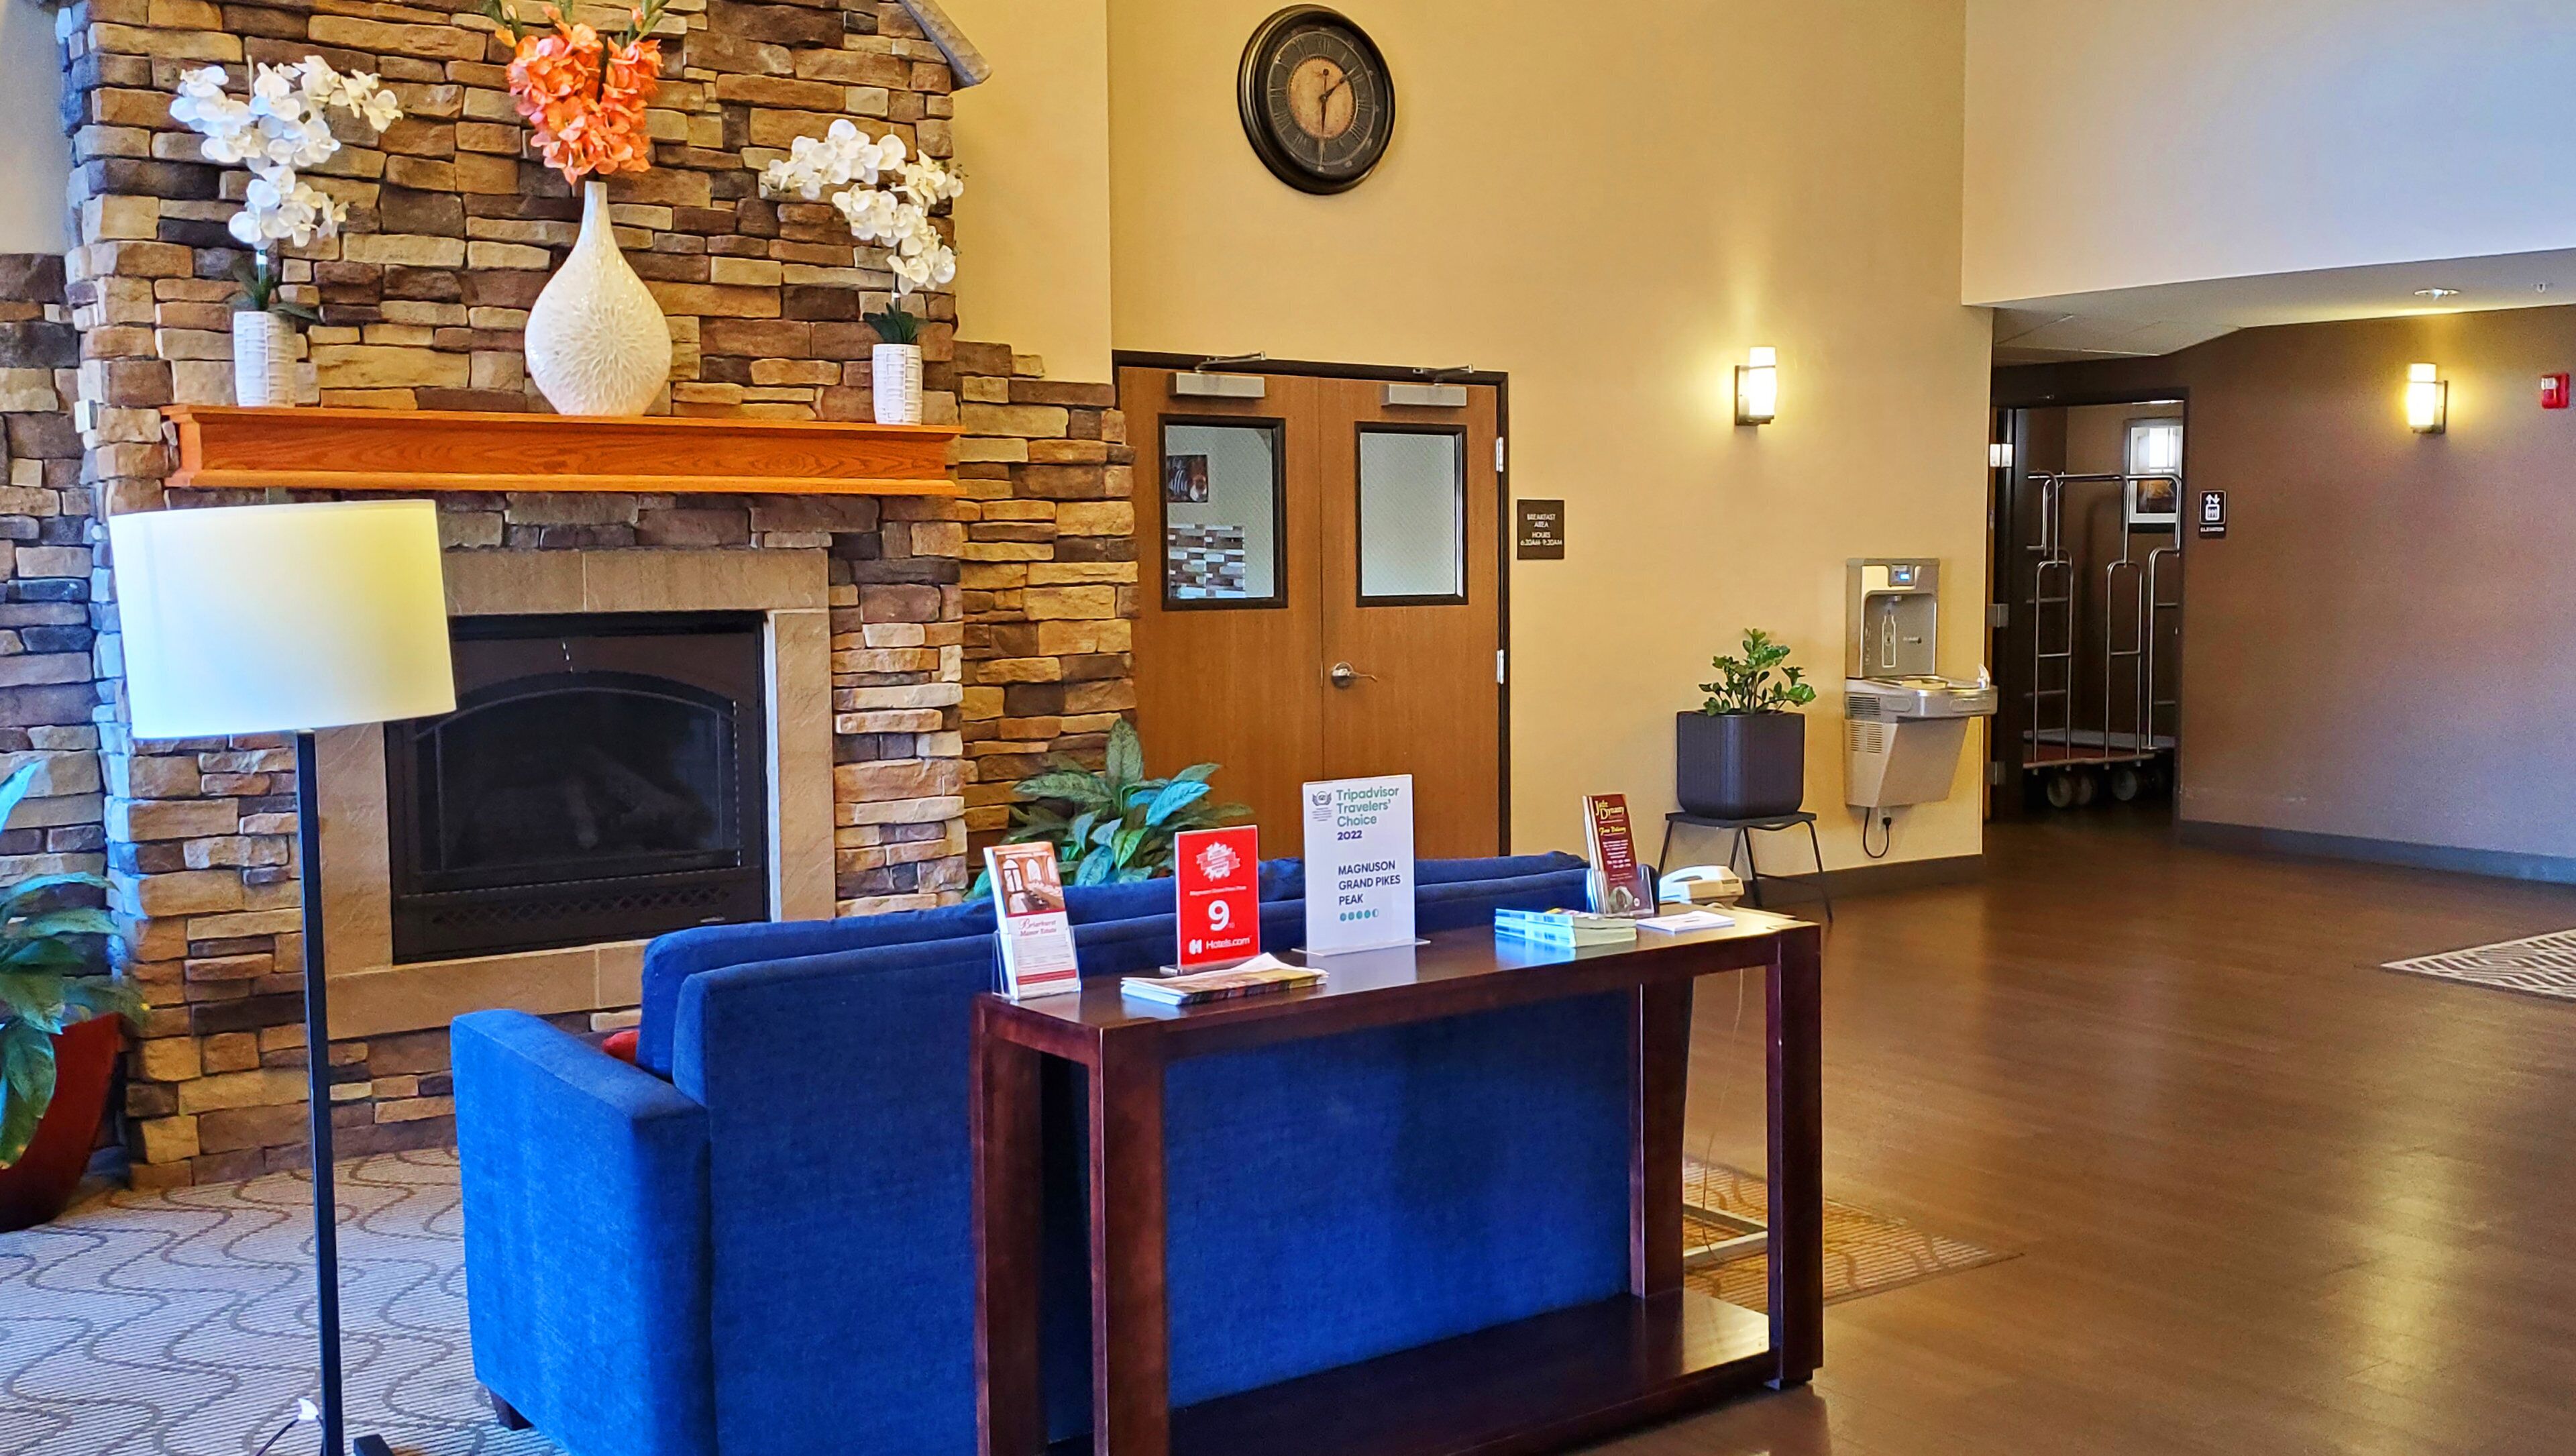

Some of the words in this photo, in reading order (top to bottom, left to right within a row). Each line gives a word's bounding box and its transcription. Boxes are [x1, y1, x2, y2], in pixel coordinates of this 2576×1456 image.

[1336, 786, 1400, 802] Tripadvisor
[1337, 814, 1377, 827] Choice
[1337, 830, 1362, 841] 2022
[1338, 860, 1395, 876] MAGNUSON
[1338, 878, 1373, 890] GRAND
[1375, 875, 1401, 887] PIKES
[1339, 894, 1363, 906] PEAK
[1208, 899, 1230, 931] 9
[1205, 936, 1250, 950] Hotels.com
